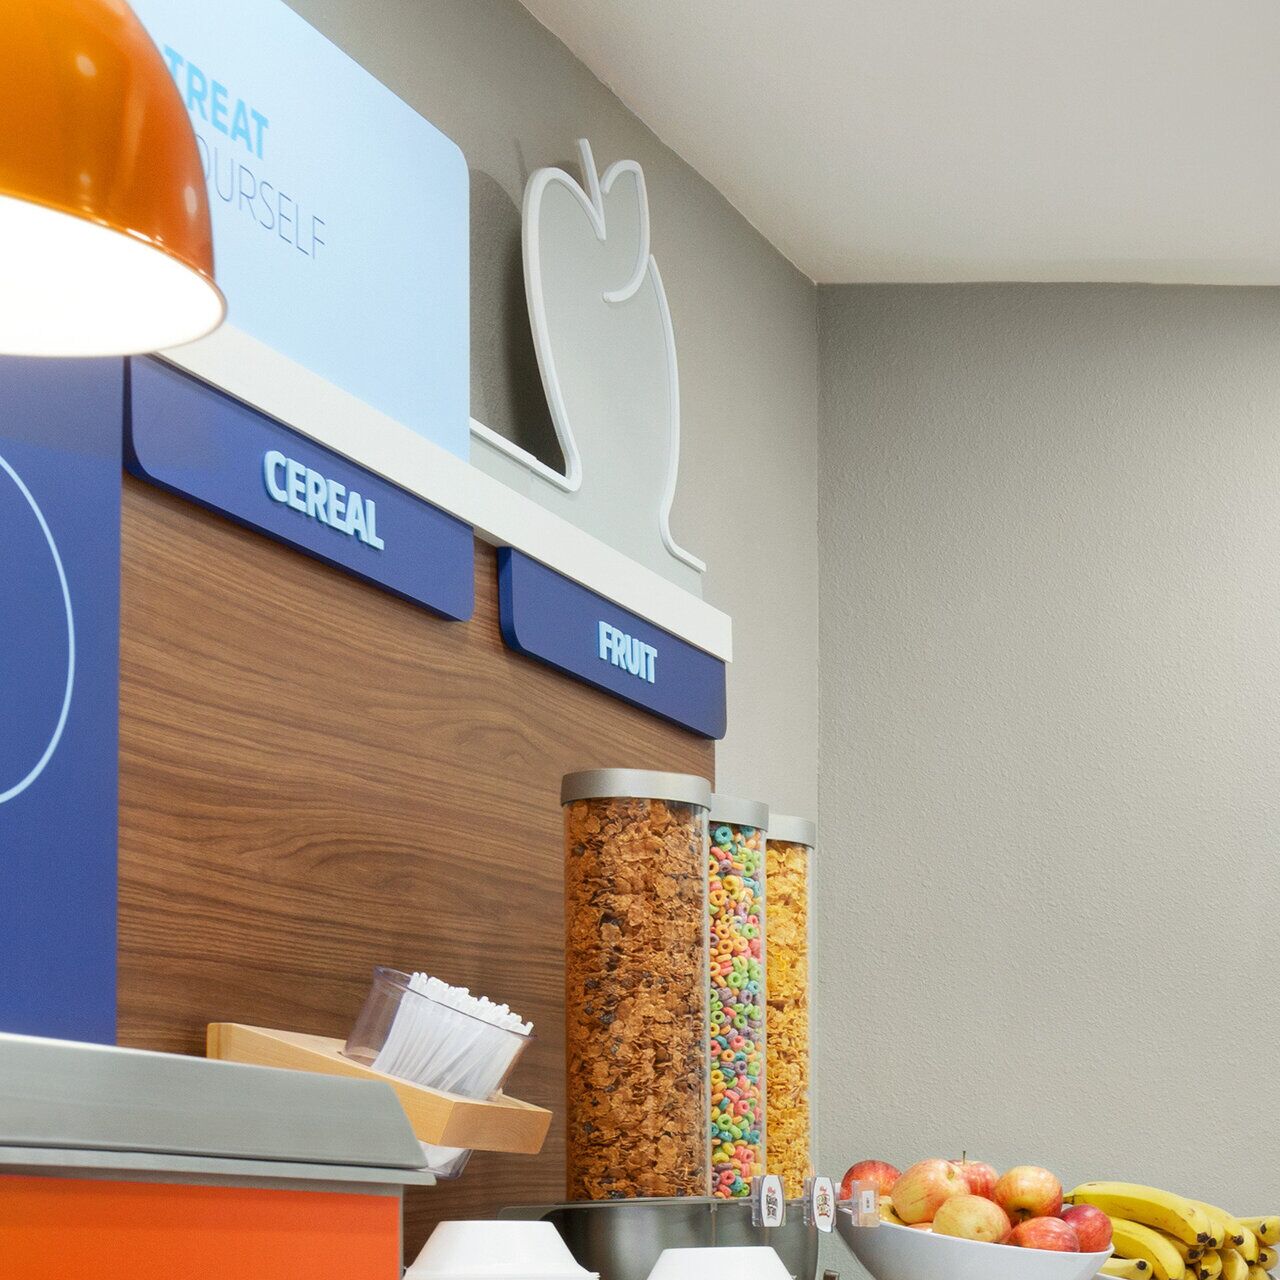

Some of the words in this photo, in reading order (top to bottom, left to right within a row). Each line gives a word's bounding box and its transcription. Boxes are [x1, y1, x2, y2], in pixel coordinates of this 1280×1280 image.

[164, 44, 269, 160] TREAT
[195, 134, 325, 259] OURSELF
[264, 450, 384, 550] CEREAL
[599, 620, 657, 683] FRUIT
